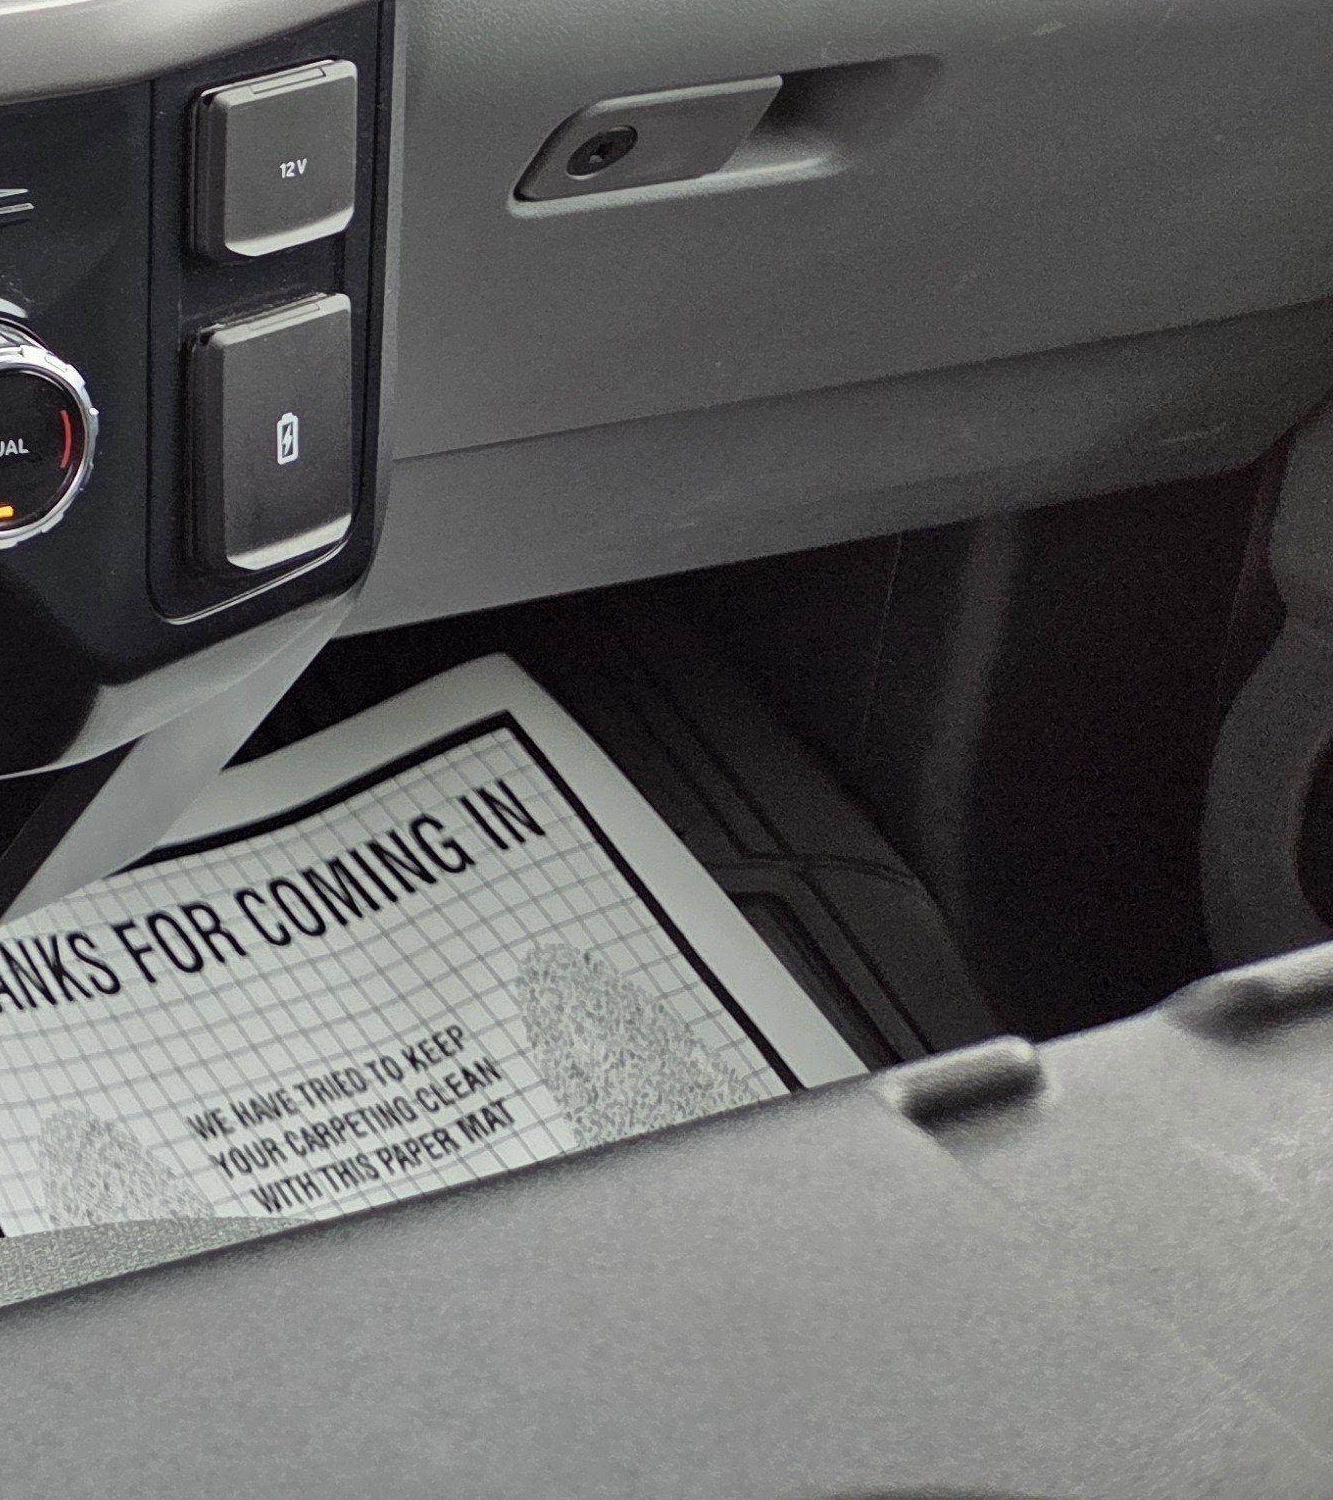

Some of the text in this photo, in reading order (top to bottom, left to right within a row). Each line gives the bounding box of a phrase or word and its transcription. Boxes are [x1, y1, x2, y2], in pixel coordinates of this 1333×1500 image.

[278, 158, 308, 179] 12V
[111, 902, 248, 984] FOR
[235, 813, 476, 948] COMING
[457, 778, 546, 852] IN
[186, 1024, 465, 1141] WE HAVE TRIED TO KEEP
[210, 1056, 503, 1180] YOUR CARPETING CLEAN
[249, 1099, 516, 1214] WITH THIS PAPER MAT
